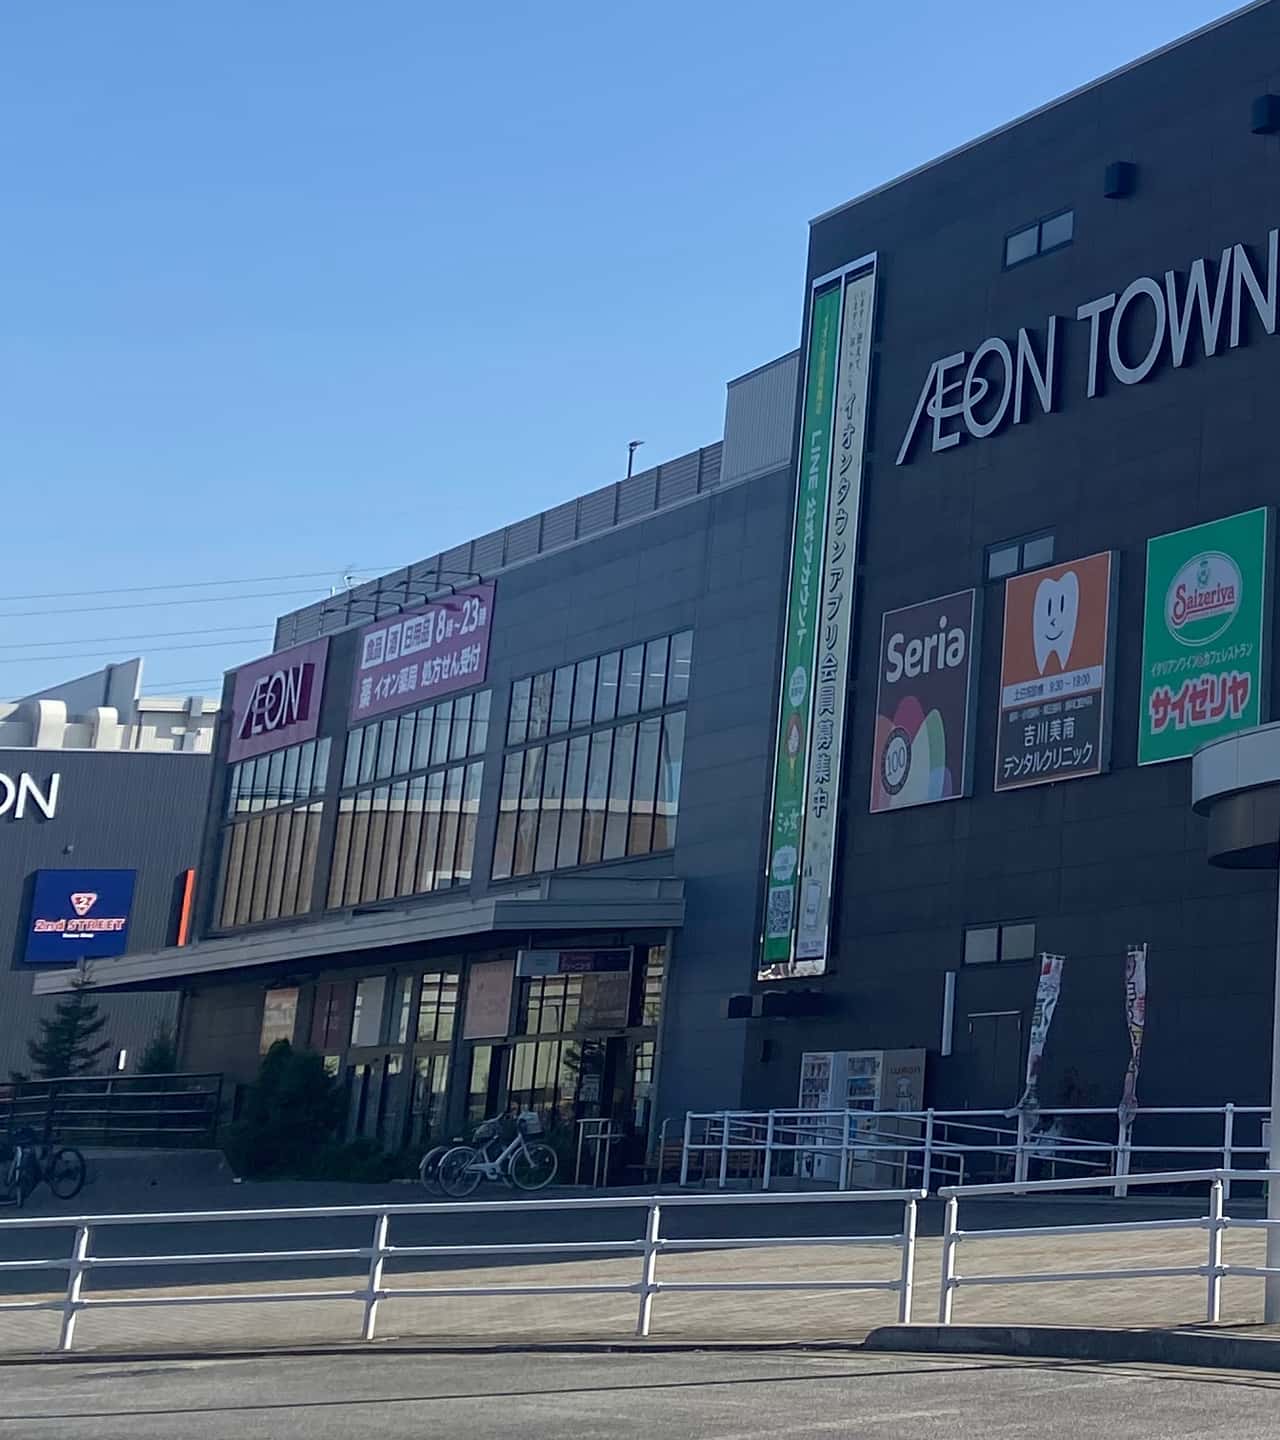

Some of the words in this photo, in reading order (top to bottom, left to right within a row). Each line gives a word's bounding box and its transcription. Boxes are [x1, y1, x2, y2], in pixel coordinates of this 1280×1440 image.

[1077, 228, 1280, 400] TOWN
[808, 429, 823, 490] LINE
[1172, 583, 1236, 622] Saizeriya
[886, 615, 965, 683] Seria
[1151, 672, 1250, 733] サイゼリヤ
[1023, 716, 1076, 747] 吉川美南
[886, 745, 907, 777] 100
[1003, 740, 1094, 779] デンタルクリニック
[34, 919, 65, 932] 2nd
[67, 918, 126, 932] STREET
